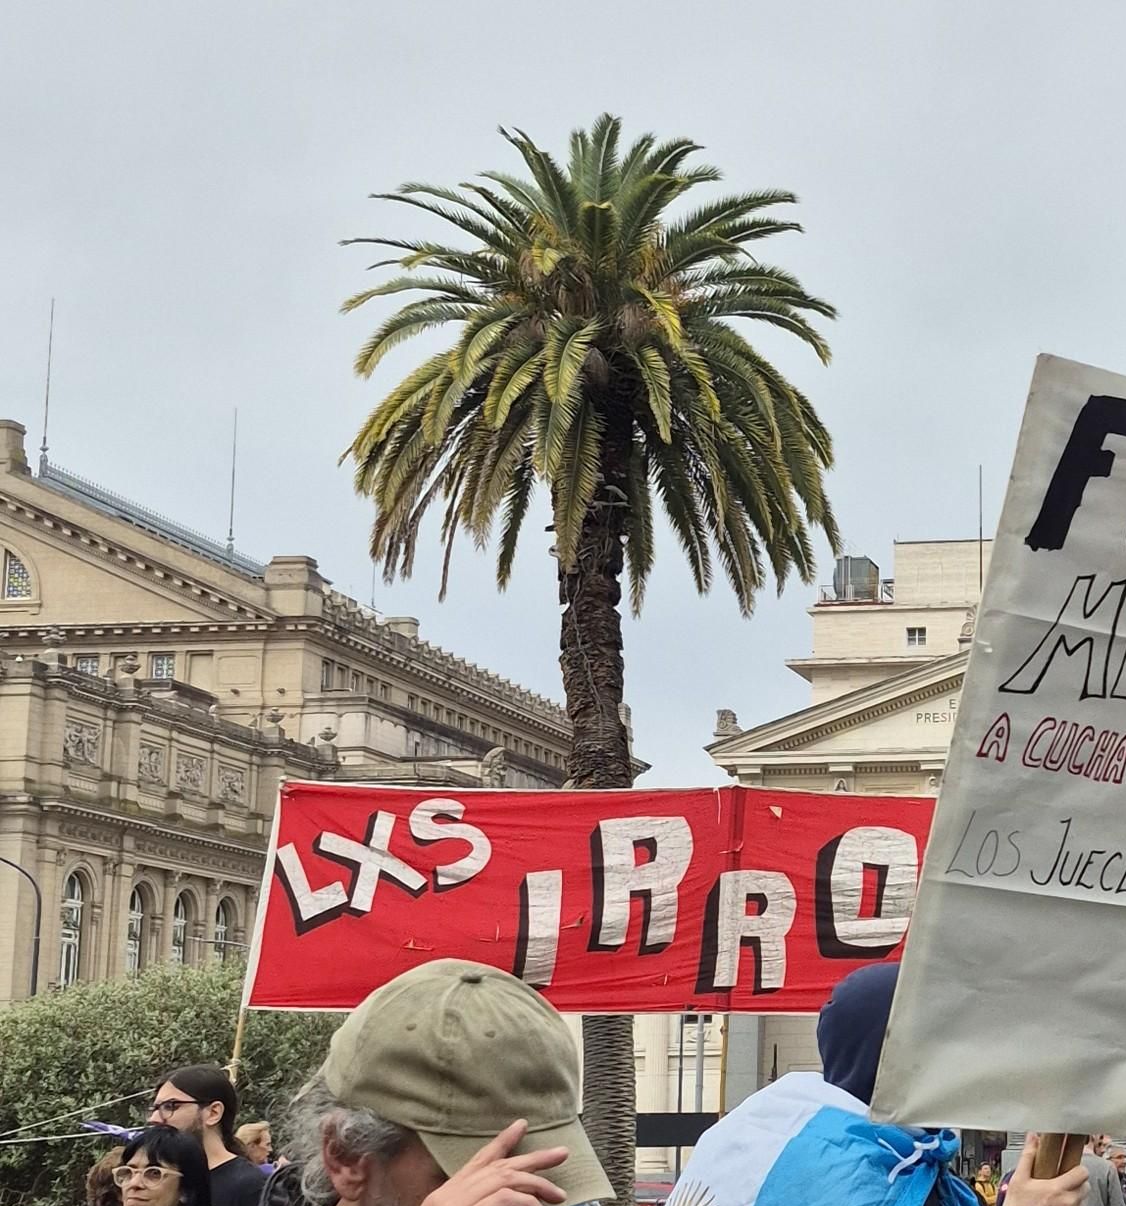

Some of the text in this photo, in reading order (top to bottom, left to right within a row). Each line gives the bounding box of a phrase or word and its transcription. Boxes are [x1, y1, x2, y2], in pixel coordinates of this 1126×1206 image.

[916, 712, 955, 723] PRESI
[976, 712, 1011, 763] A
[275, 798, 492, 936] LXS
[945, 810, 1021, 879] LOS
